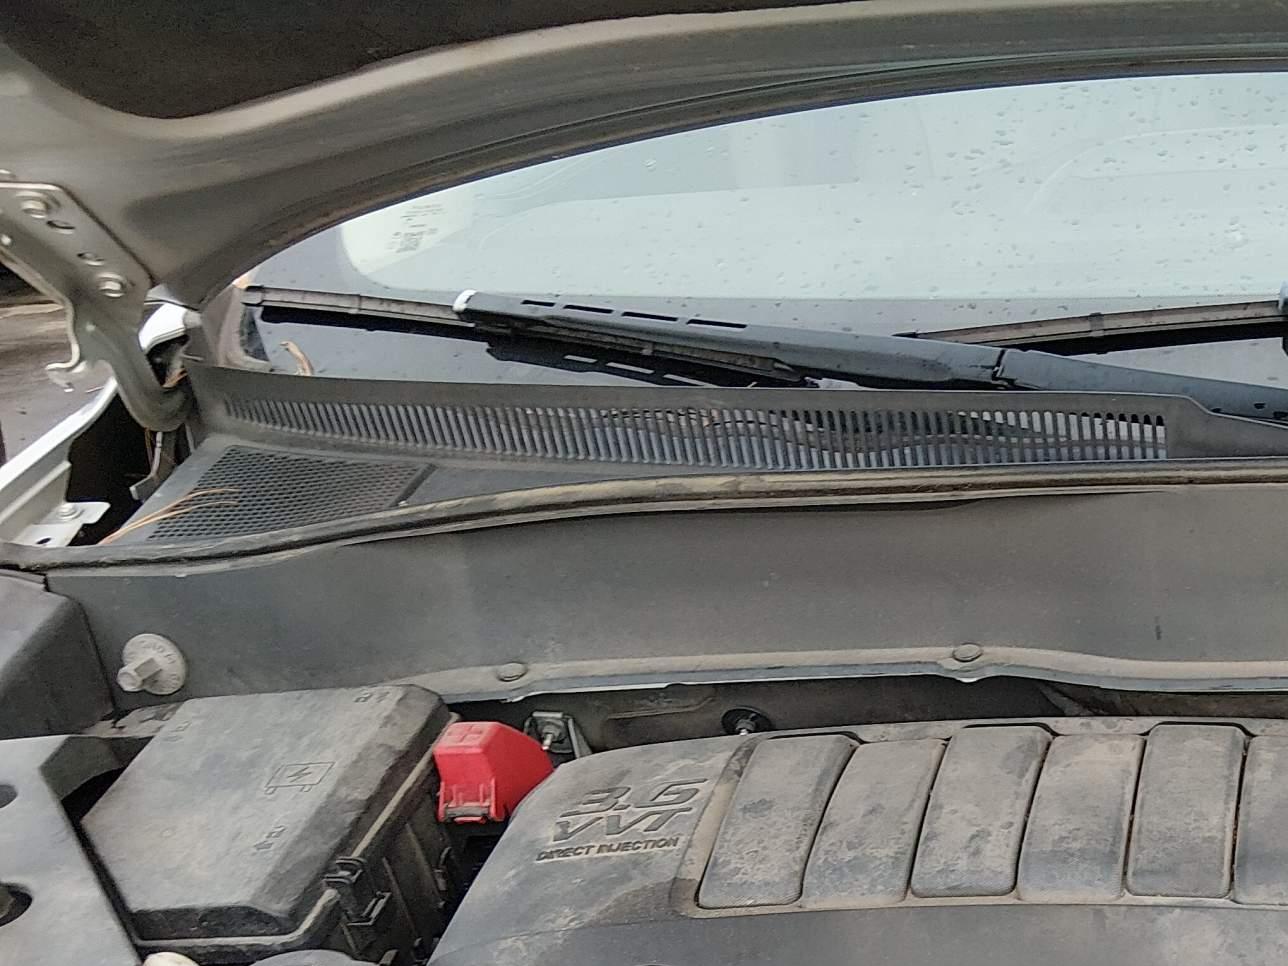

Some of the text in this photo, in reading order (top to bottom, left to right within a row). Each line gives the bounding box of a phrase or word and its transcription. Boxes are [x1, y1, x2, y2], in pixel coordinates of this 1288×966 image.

[560, 779, 708, 818] 3.6
[553, 807, 693, 842] VVT
[536, 837, 680, 862] DIRECT INJECTION
